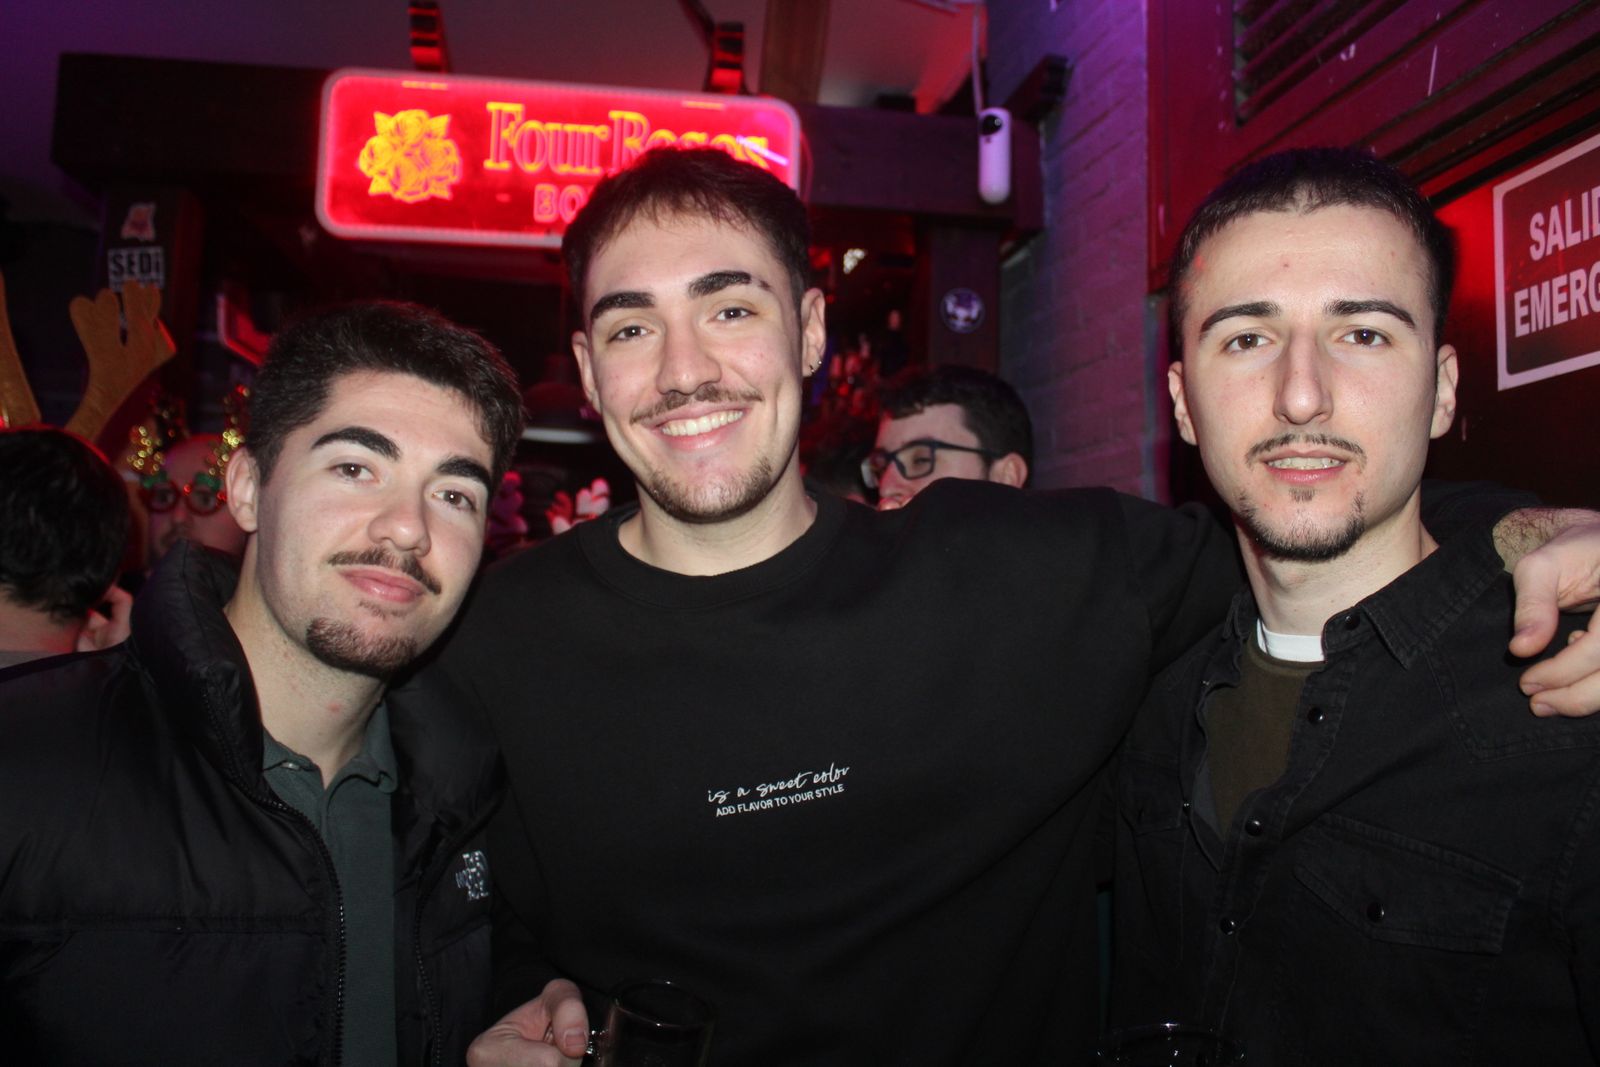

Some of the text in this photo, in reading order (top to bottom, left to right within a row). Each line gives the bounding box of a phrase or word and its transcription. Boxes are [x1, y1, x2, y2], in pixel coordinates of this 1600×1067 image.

[483, 101, 610, 175] Four
[707, 762, 850, 804] is a sweet color
[715, 783, 845, 817] ADD FLAVOR TO YOUR STYLE
